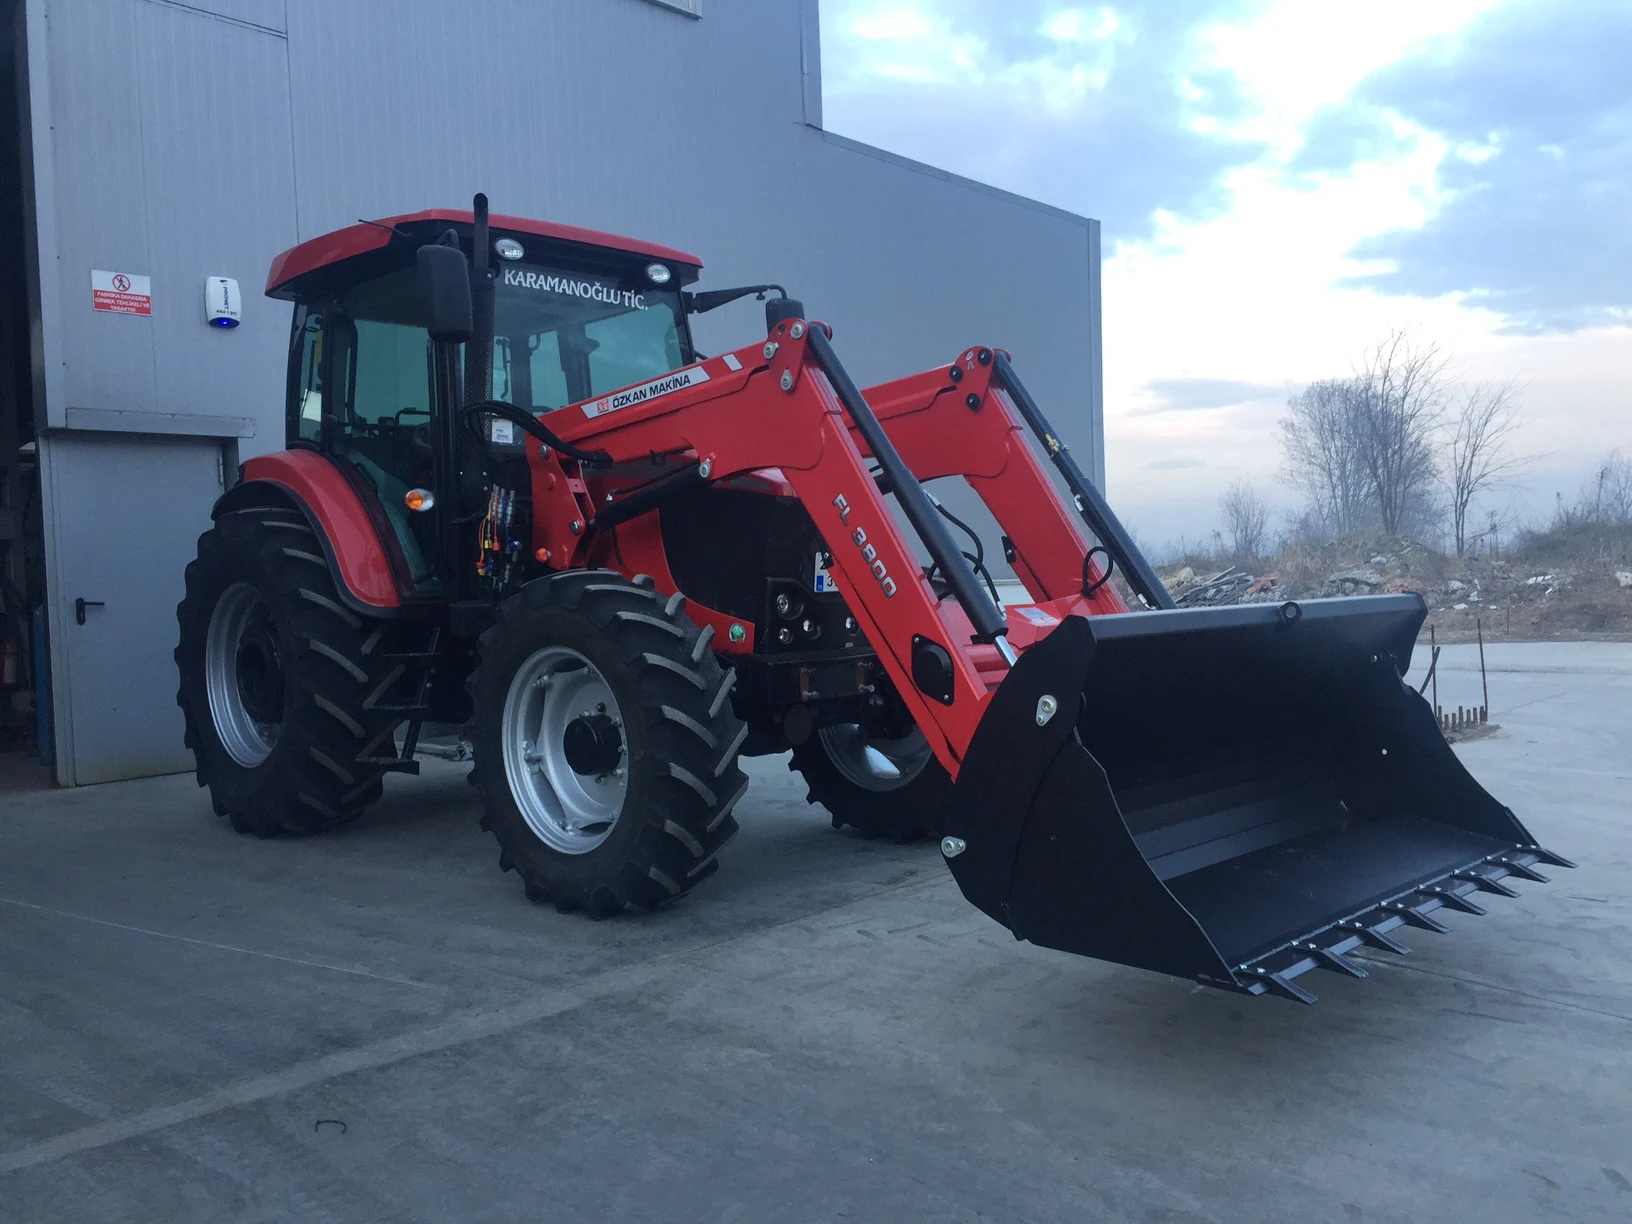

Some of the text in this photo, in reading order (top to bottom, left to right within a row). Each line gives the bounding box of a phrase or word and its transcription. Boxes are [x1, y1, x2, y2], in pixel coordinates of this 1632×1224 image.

[504, 269, 649, 310] KARAMANOĞLU TİC.
[612, 374, 692, 409] ÖZKAN MAKİNA
[833, 493, 897, 599] FL 3800
